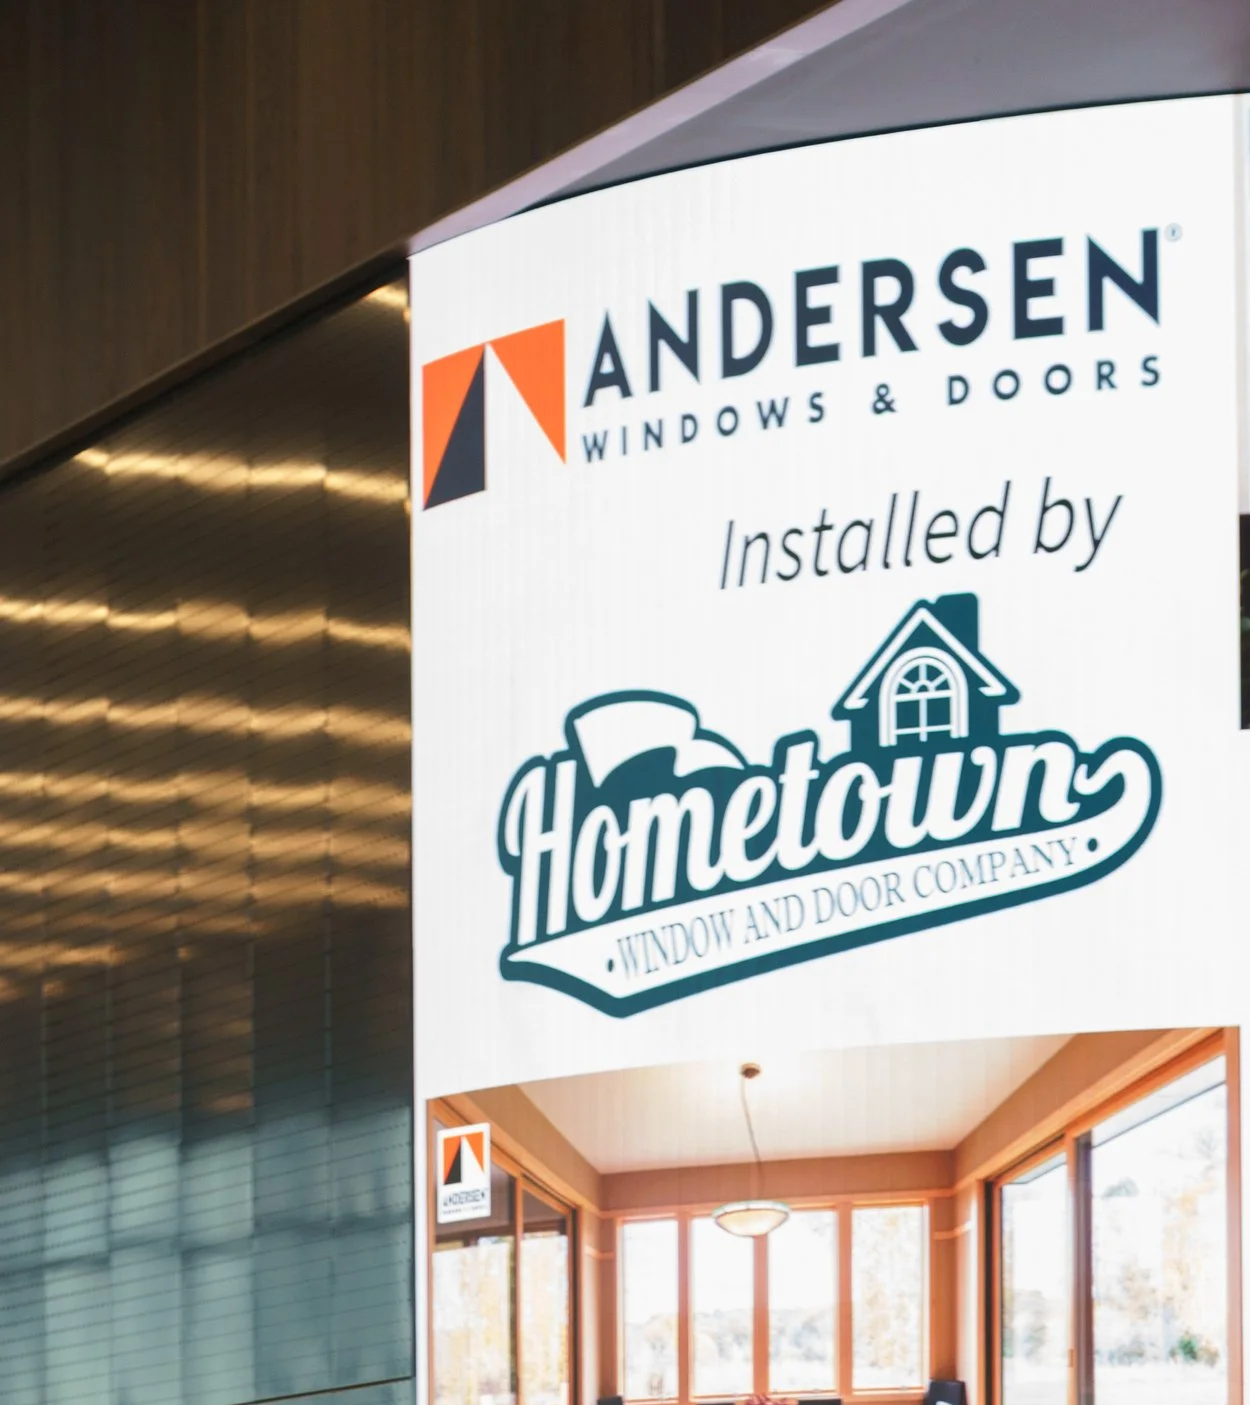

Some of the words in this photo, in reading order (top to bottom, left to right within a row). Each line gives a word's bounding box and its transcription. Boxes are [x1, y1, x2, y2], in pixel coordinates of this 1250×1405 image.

[583, 227, 1161, 409] ANDERSEN
[583, 393, 825, 464] WINDOWS
[872, 385, 897, 415] &
[948, 355, 1162, 407] DOORS
[718, 479, 1014, 591] Installed
[1032, 476, 1124, 573] by
[504, 740, 1090, 946] Hometown
[616, 908, 735, 980] WINDOW
[743, 892, 806, 944] AND
[814, 869, 905, 928] DOOR
[911, 835, 1078, 898] COMPANY
